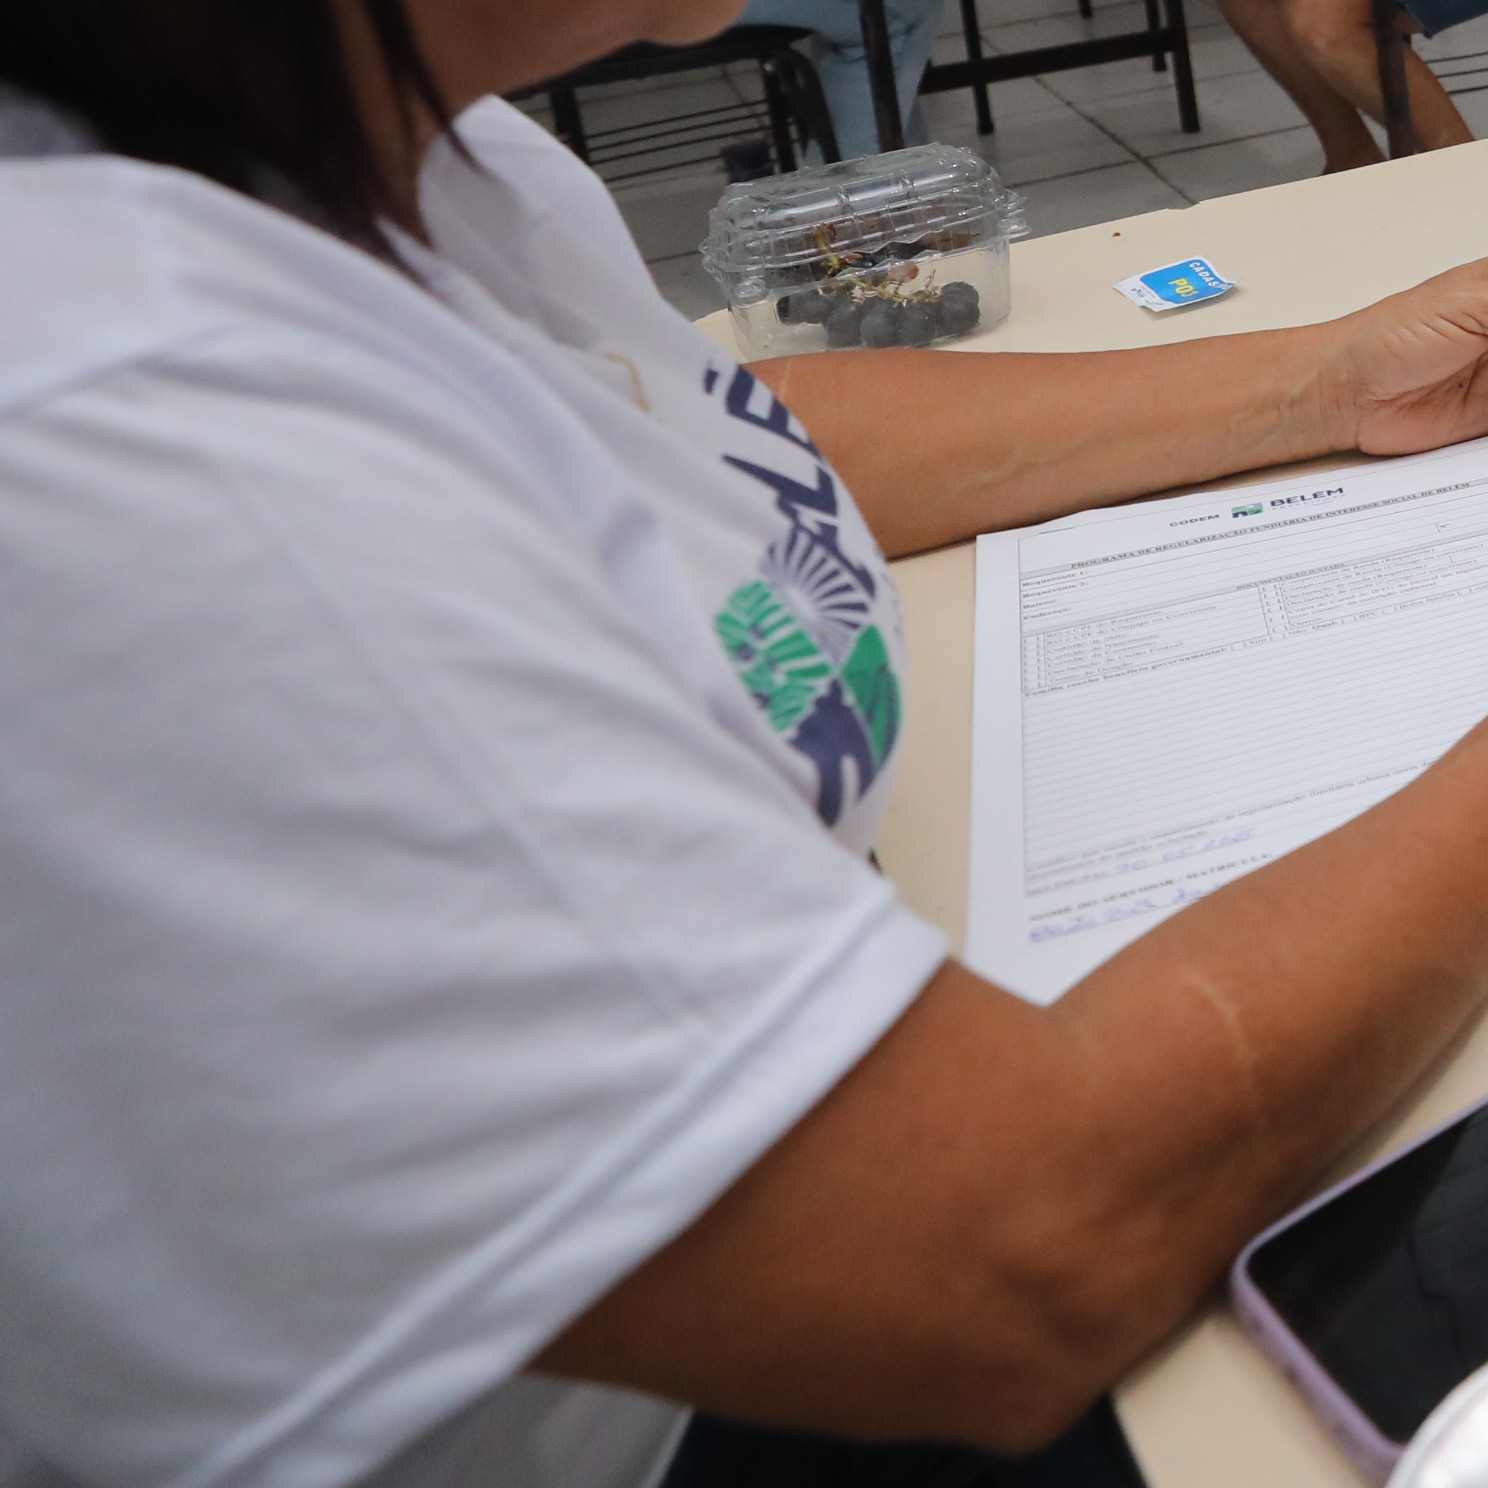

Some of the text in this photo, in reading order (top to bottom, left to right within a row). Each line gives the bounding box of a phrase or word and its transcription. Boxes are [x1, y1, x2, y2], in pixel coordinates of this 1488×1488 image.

[1269, 487, 1345, 508] BELÉM
[1071, 553, 1134, 568] PROGRAMA
[1152, 527, 1248, 552] REGULARIZAÇÃO
[1309, 513, 1323, 522] DE
[1325, 504, 1379, 519] INTERESSE
[1381, 494, 1418, 507] SOCIAL
[1421, 489, 1434, 497] DE
[1437, 481, 1470, 494] BELÉM
[1168, 514, 1220, 527] CODEM
